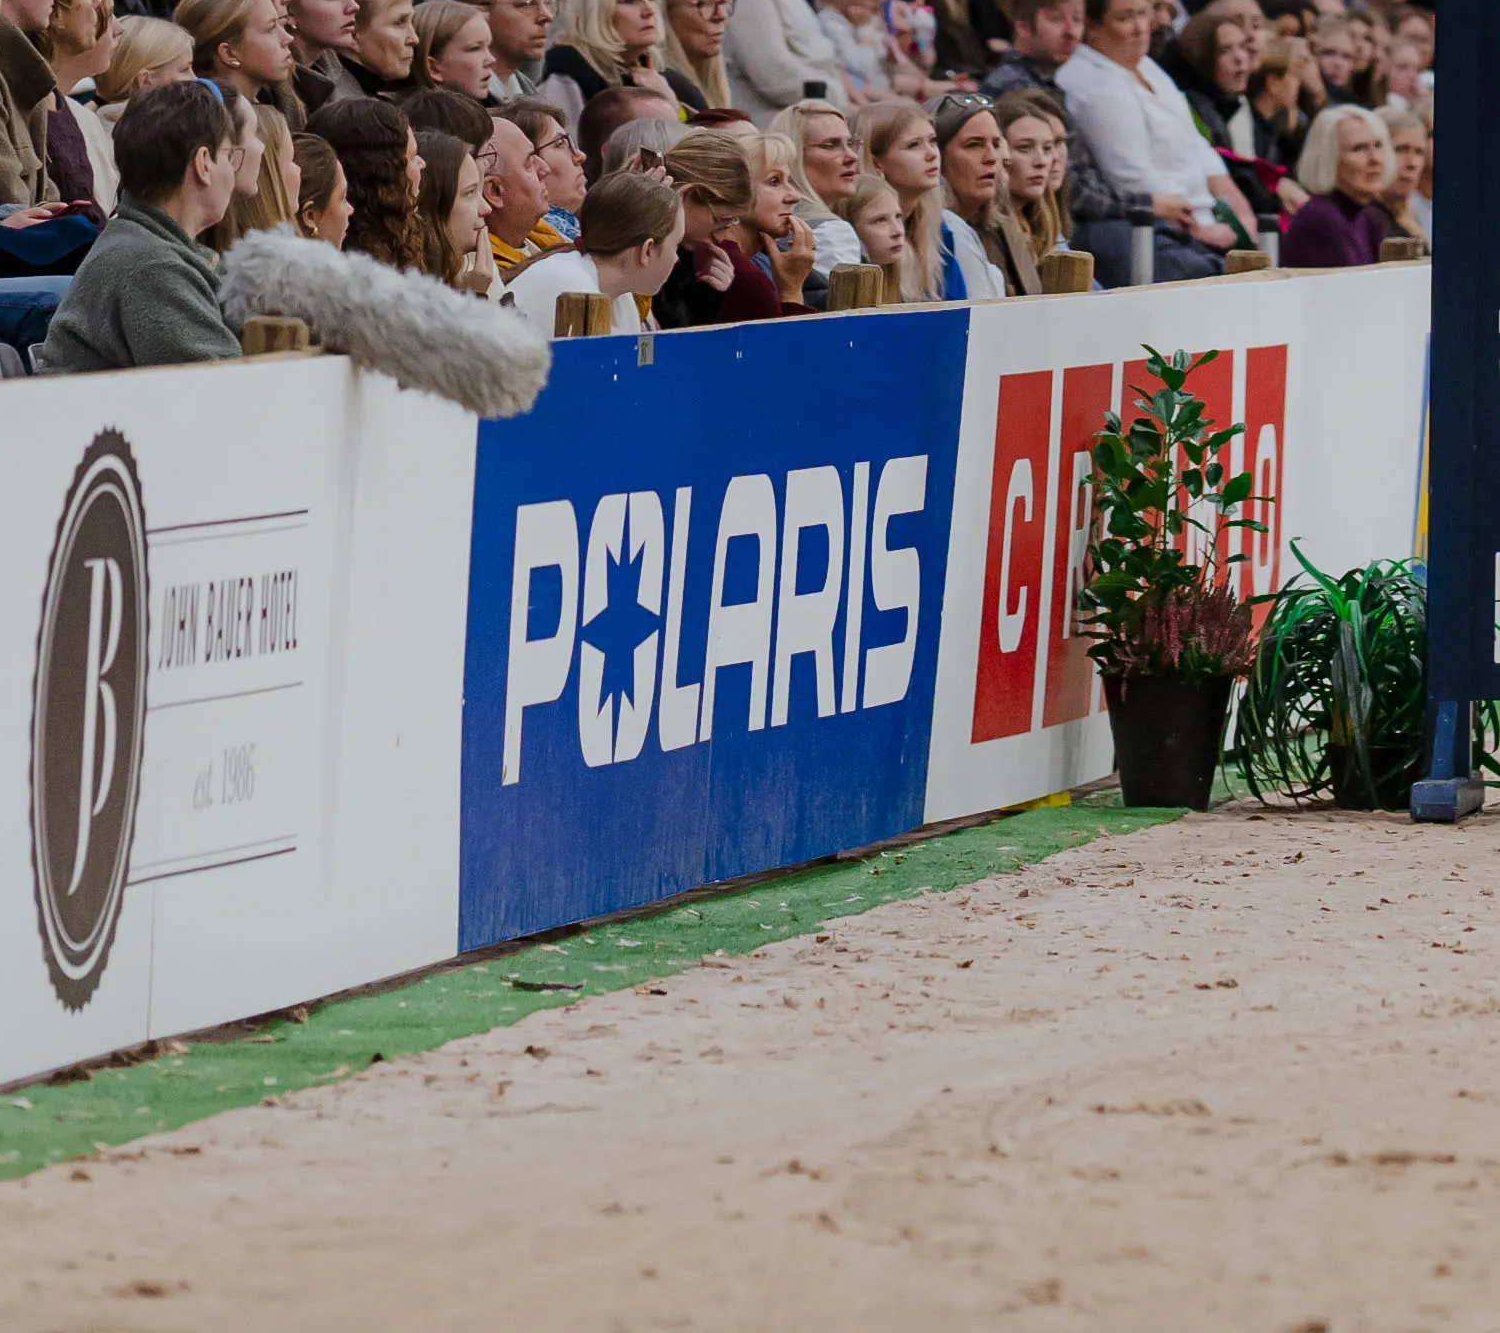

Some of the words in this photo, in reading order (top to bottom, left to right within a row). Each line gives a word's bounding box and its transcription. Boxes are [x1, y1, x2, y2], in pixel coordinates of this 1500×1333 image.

[158, 583, 200, 670] JOHN
[204, 577, 254, 664] BAUER
[258, 569, 298, 656] HOTEL
[502, 454, 928, 787] POLARIS
[220, 743, 256, 805] 1986
